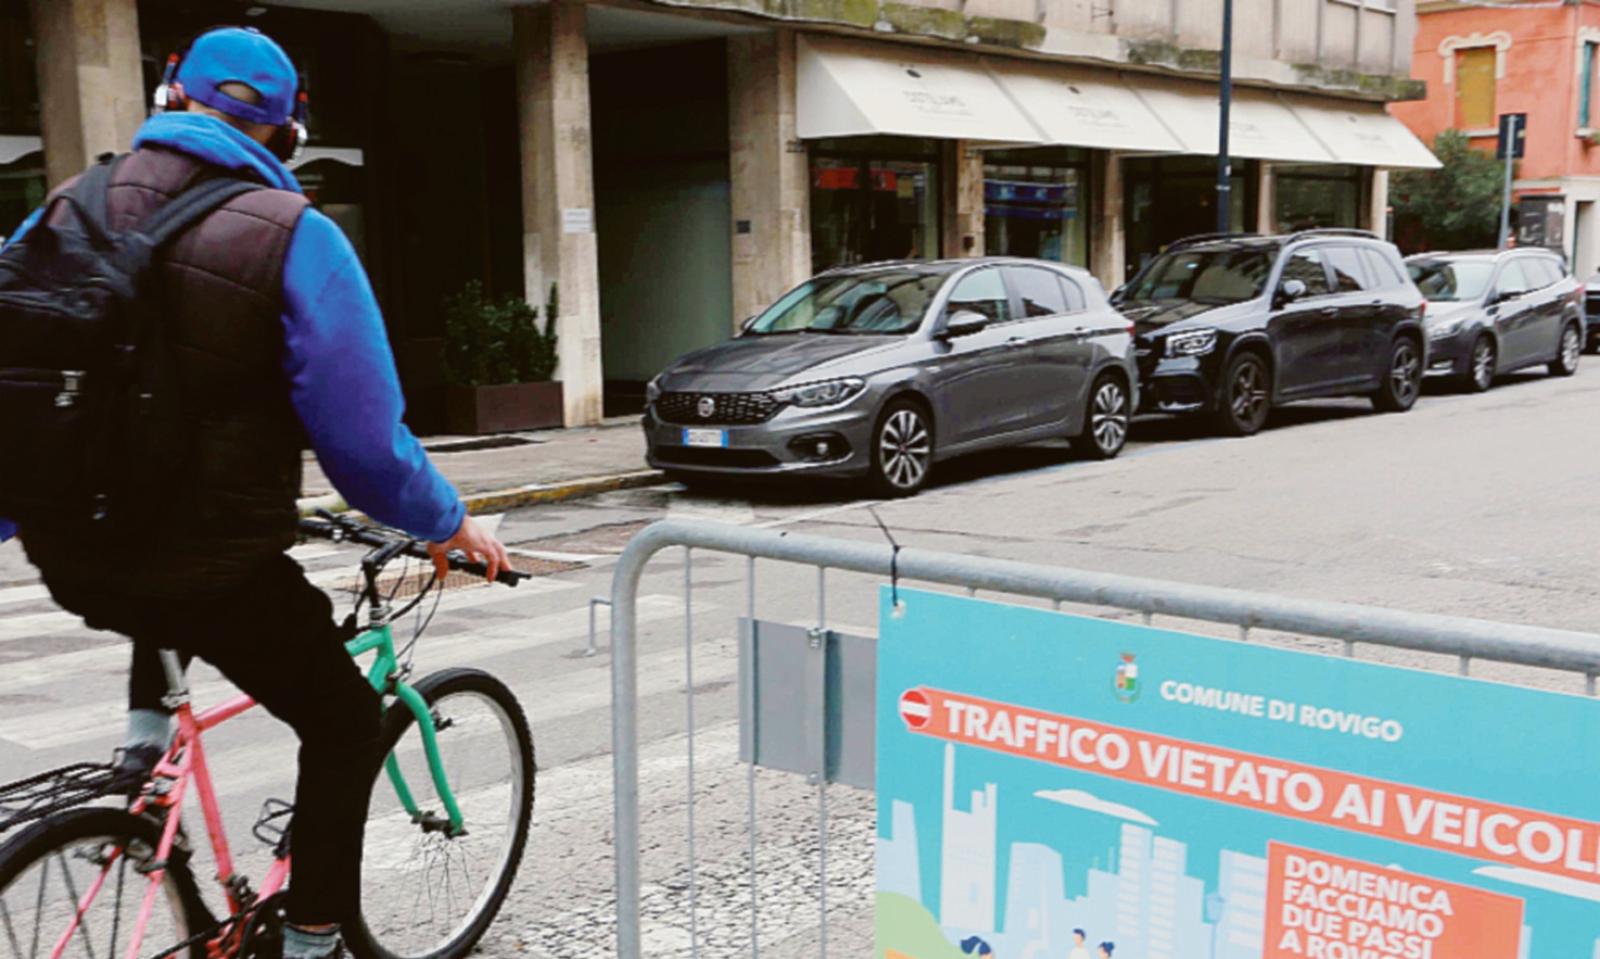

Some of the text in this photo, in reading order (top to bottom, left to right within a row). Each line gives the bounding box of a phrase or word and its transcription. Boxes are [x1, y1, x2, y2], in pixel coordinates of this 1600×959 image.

[1160, 680, 1403, 742] COMUNE DI ROVIGO
[943, 699, 1130, 770] TRAFFICO
[1137, 741, 1324, 812] VIETATO
[1331, 783, 1385, 826] AI
[1283, 879, 1445, 938] FACCIAMO
[1284, 854, 1455, 915] DOMENICA
[1279, 928, 1303, 954] A
[1281, 902, 1433, 959] DUE PASSI
